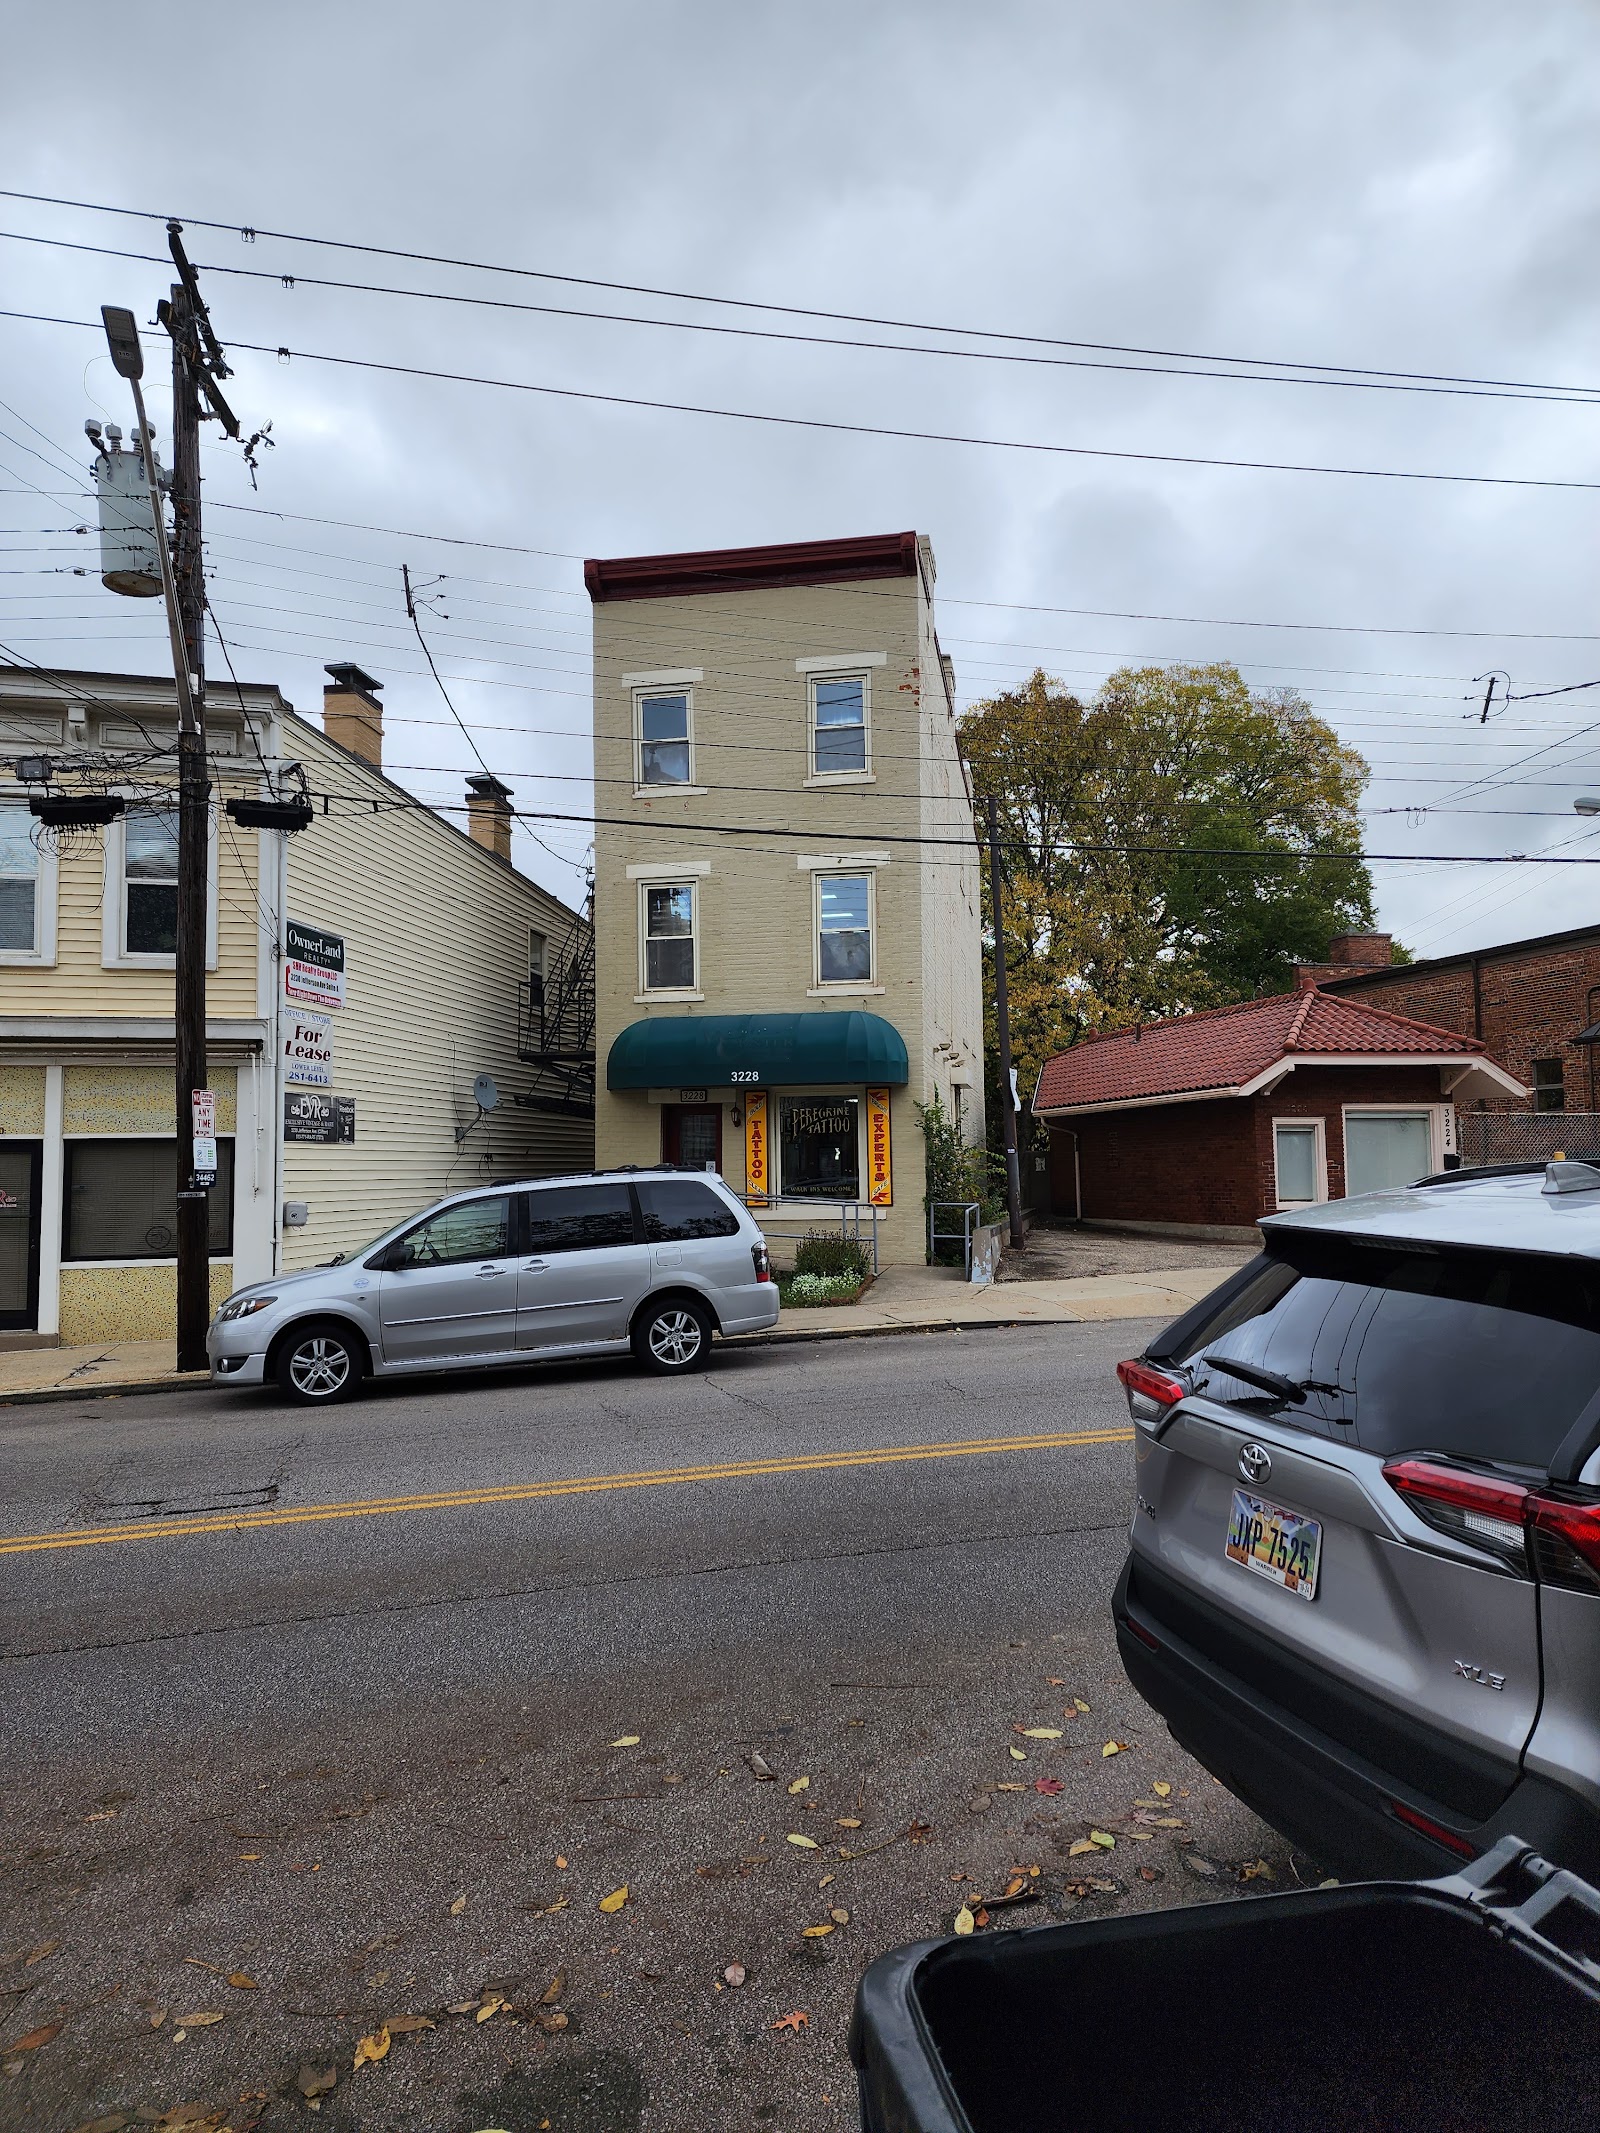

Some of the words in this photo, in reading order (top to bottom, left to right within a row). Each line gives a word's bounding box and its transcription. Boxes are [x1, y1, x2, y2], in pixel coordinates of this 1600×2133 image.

[288, 929, 342, 960] OwnerLand
[303, 951, 329, 966] REALTY
[284, 1009, 306, 1020] OFFICE
[311, 1014, 331, 1025] STORE
[295, 1025, 323, 1043] For
[285, 1040, 331, 1061] Lease
[291, 1063, 310, 1071] LOWER
[289, 1071, 328, 1083] 281-6413
[731, 1071, 759, 1082] 3228
[683, 1091, 704, 1100] 3228
[198, 1108, 211, 1117] ANY
[198, 1118, 212, 1129] TIME
[792, 1107, 850, 1138] PEREGRINE
[807, 1117, 850, 1134] TATTOO
[751, 1120, 763, 1179] TATTOO
[873, 1113, 885, 1181] EXPERTS
[195, 1173, 215, 1182] 34462
[822, 1185, 852, 1193] WELCOME
[1233, 1513, 1262, 1556] JXP
[1268, 1527, 1311, 1580] 7525
[1255, 1560, 1277, 1576] WARREN
[1452, 1660, 1506, 1691] XLE
